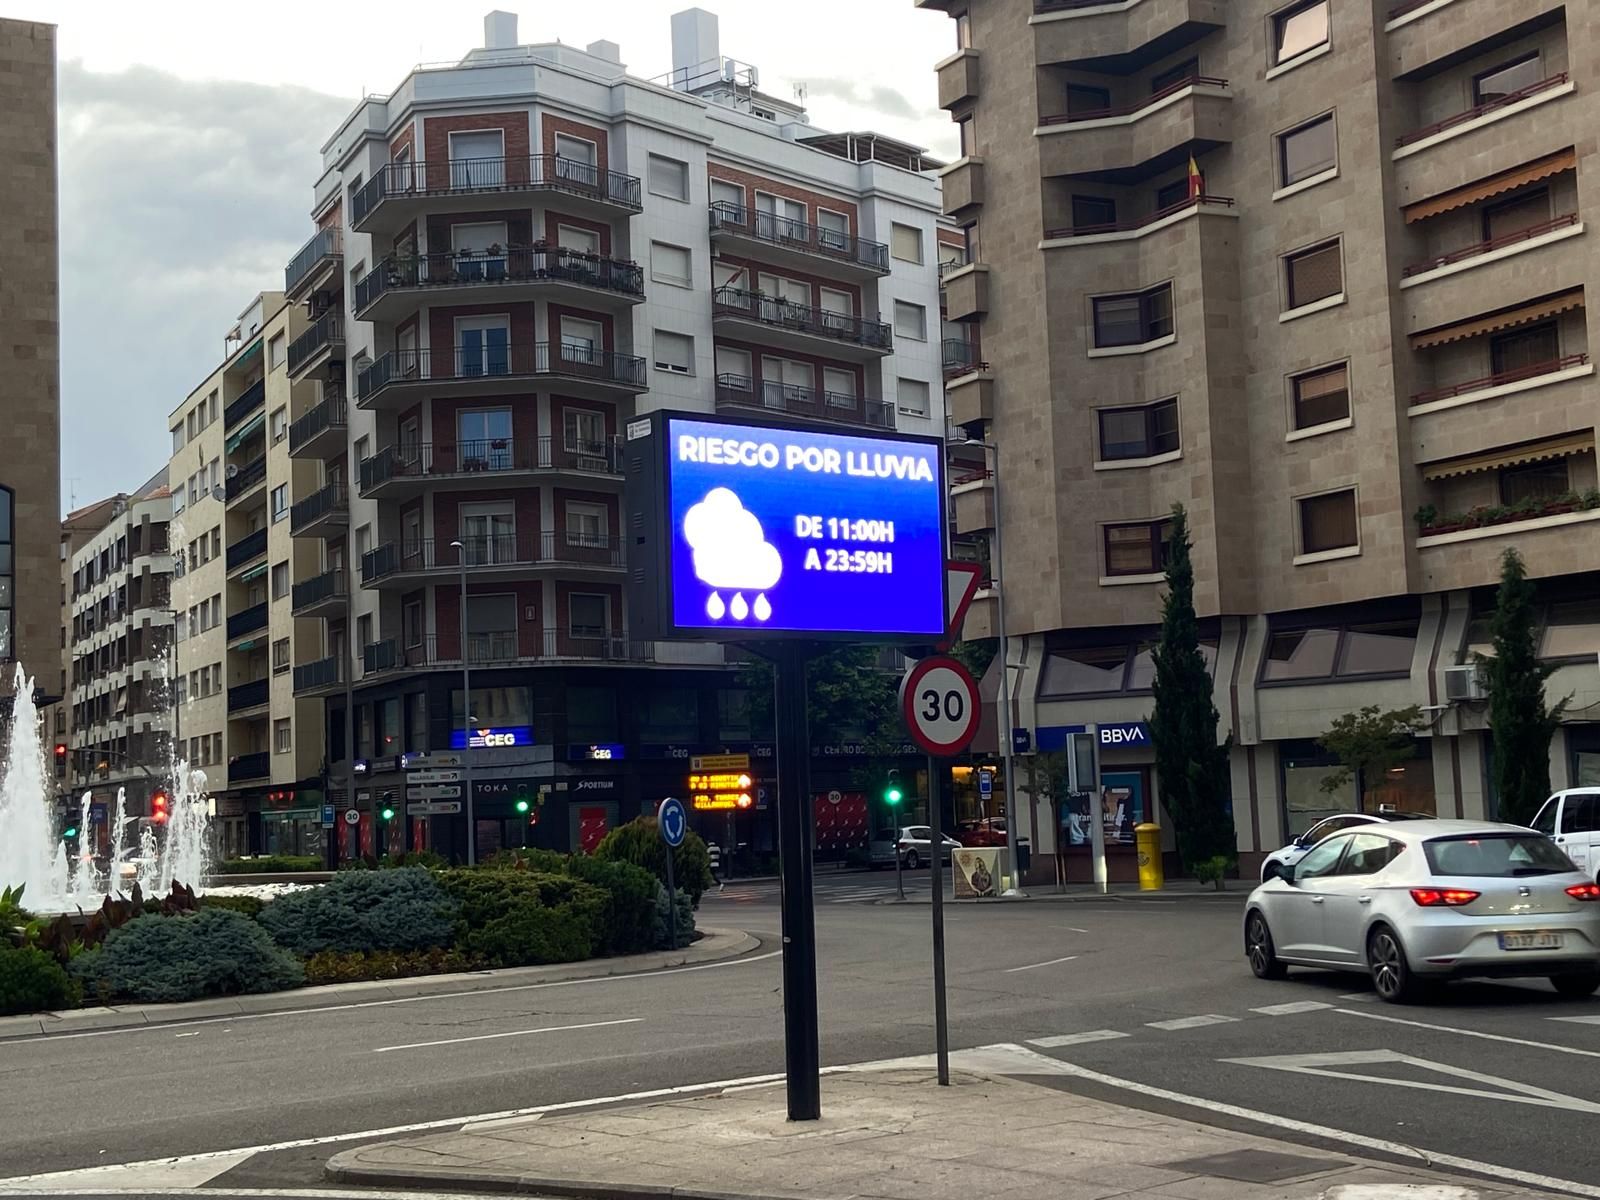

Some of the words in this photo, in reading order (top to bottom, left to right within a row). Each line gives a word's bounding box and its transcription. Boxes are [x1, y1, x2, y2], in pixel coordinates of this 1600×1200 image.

[679, 435, 780, 468] RIESGO
[785, 445, 842, 474] POR
[847, 452, 934, 482] LLUVIA
[795, 514, 824, 539] DE
[827, 517, 895, 543] 11:00H
[804, 547, 823, 571] A
[825, 548, 893, 574] 23:59H
[921, 688, 965, 723] 30
[484, 733, 516, 747] CEG
[1100, 726, 1145, 744] BBVA
[593, 749, 612, 760] CEG
[672, 748, 688, 758] CEG
[757, 747, 772, 757] CEG
[476, 784, 509, 793] TOKA
[573, 780, 615, 792] SPORTIUM
[830, 793, 840, 801] 30
[346, 812, 358, 820] 30
